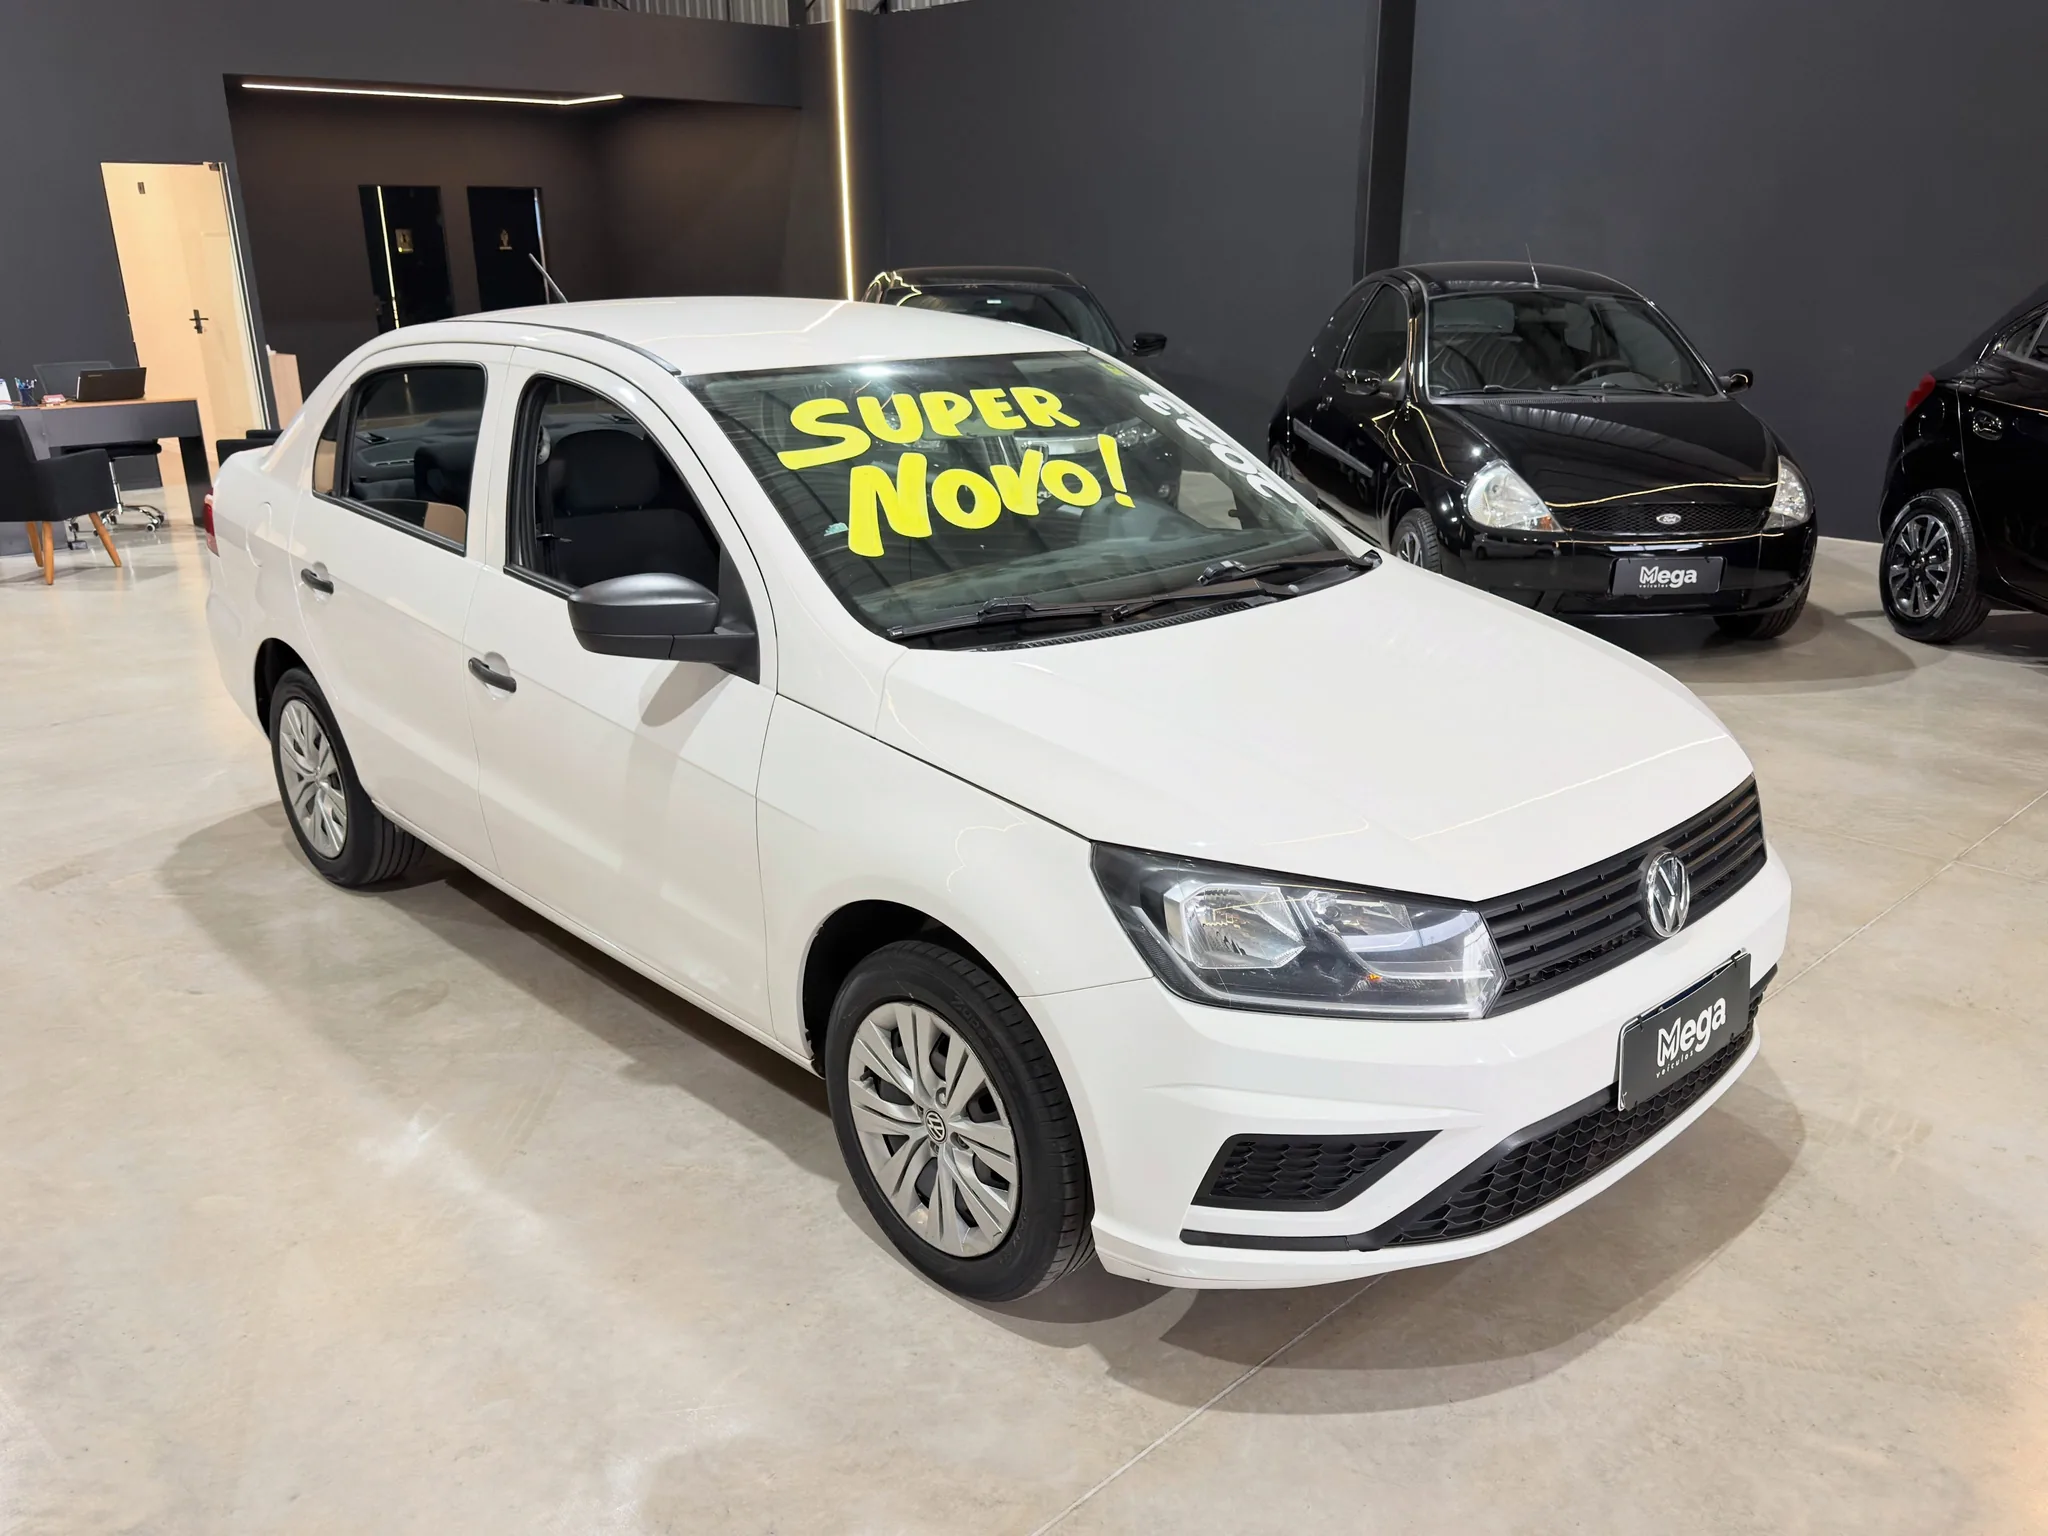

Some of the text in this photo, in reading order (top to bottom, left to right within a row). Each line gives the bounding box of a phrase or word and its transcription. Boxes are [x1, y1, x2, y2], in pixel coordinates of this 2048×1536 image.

[777, 386, 1080, 470] SUPER
[1138, 392, 1299, 505] 2023
[848, 434, 1136, 557] NOVO!
[1639, 566, 1698, 589] Mega
[1656, 997, 1726, 1068] Mega
